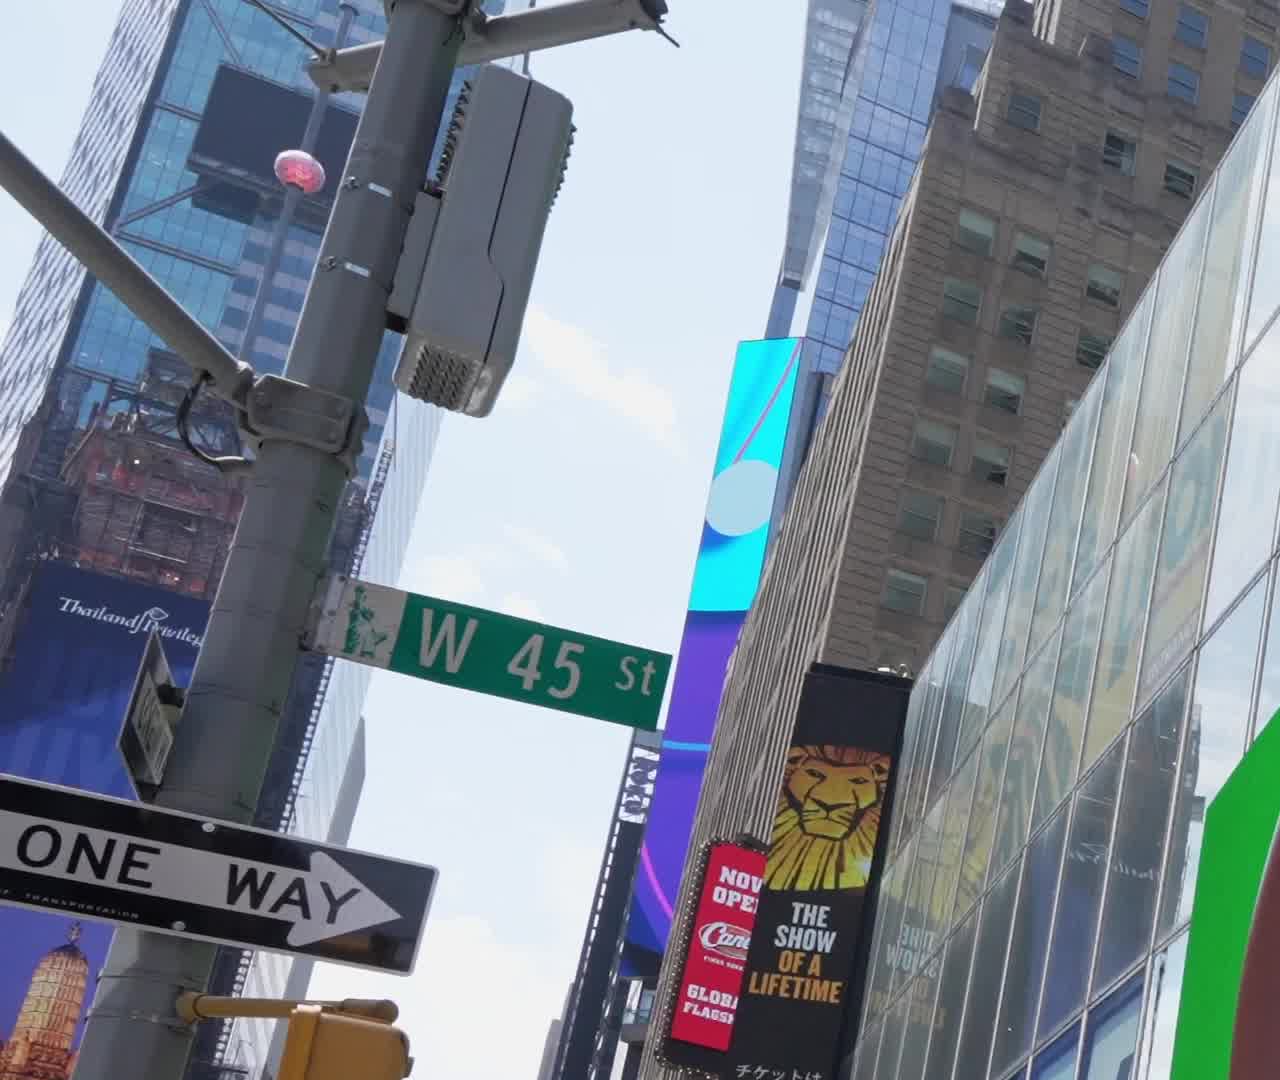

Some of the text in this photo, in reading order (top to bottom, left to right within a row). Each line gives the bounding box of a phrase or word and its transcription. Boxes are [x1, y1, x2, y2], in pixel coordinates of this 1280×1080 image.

[419, 608, 656, 699] W 45 St
[16, 824, 360, 925] ONE WAY
[791, 902, 831, 928] THE
[774, 925, 837, 953] SHOW
[778, 950, 822, 977] OF A
[749, 971, 842, 1003] LIFETIME
